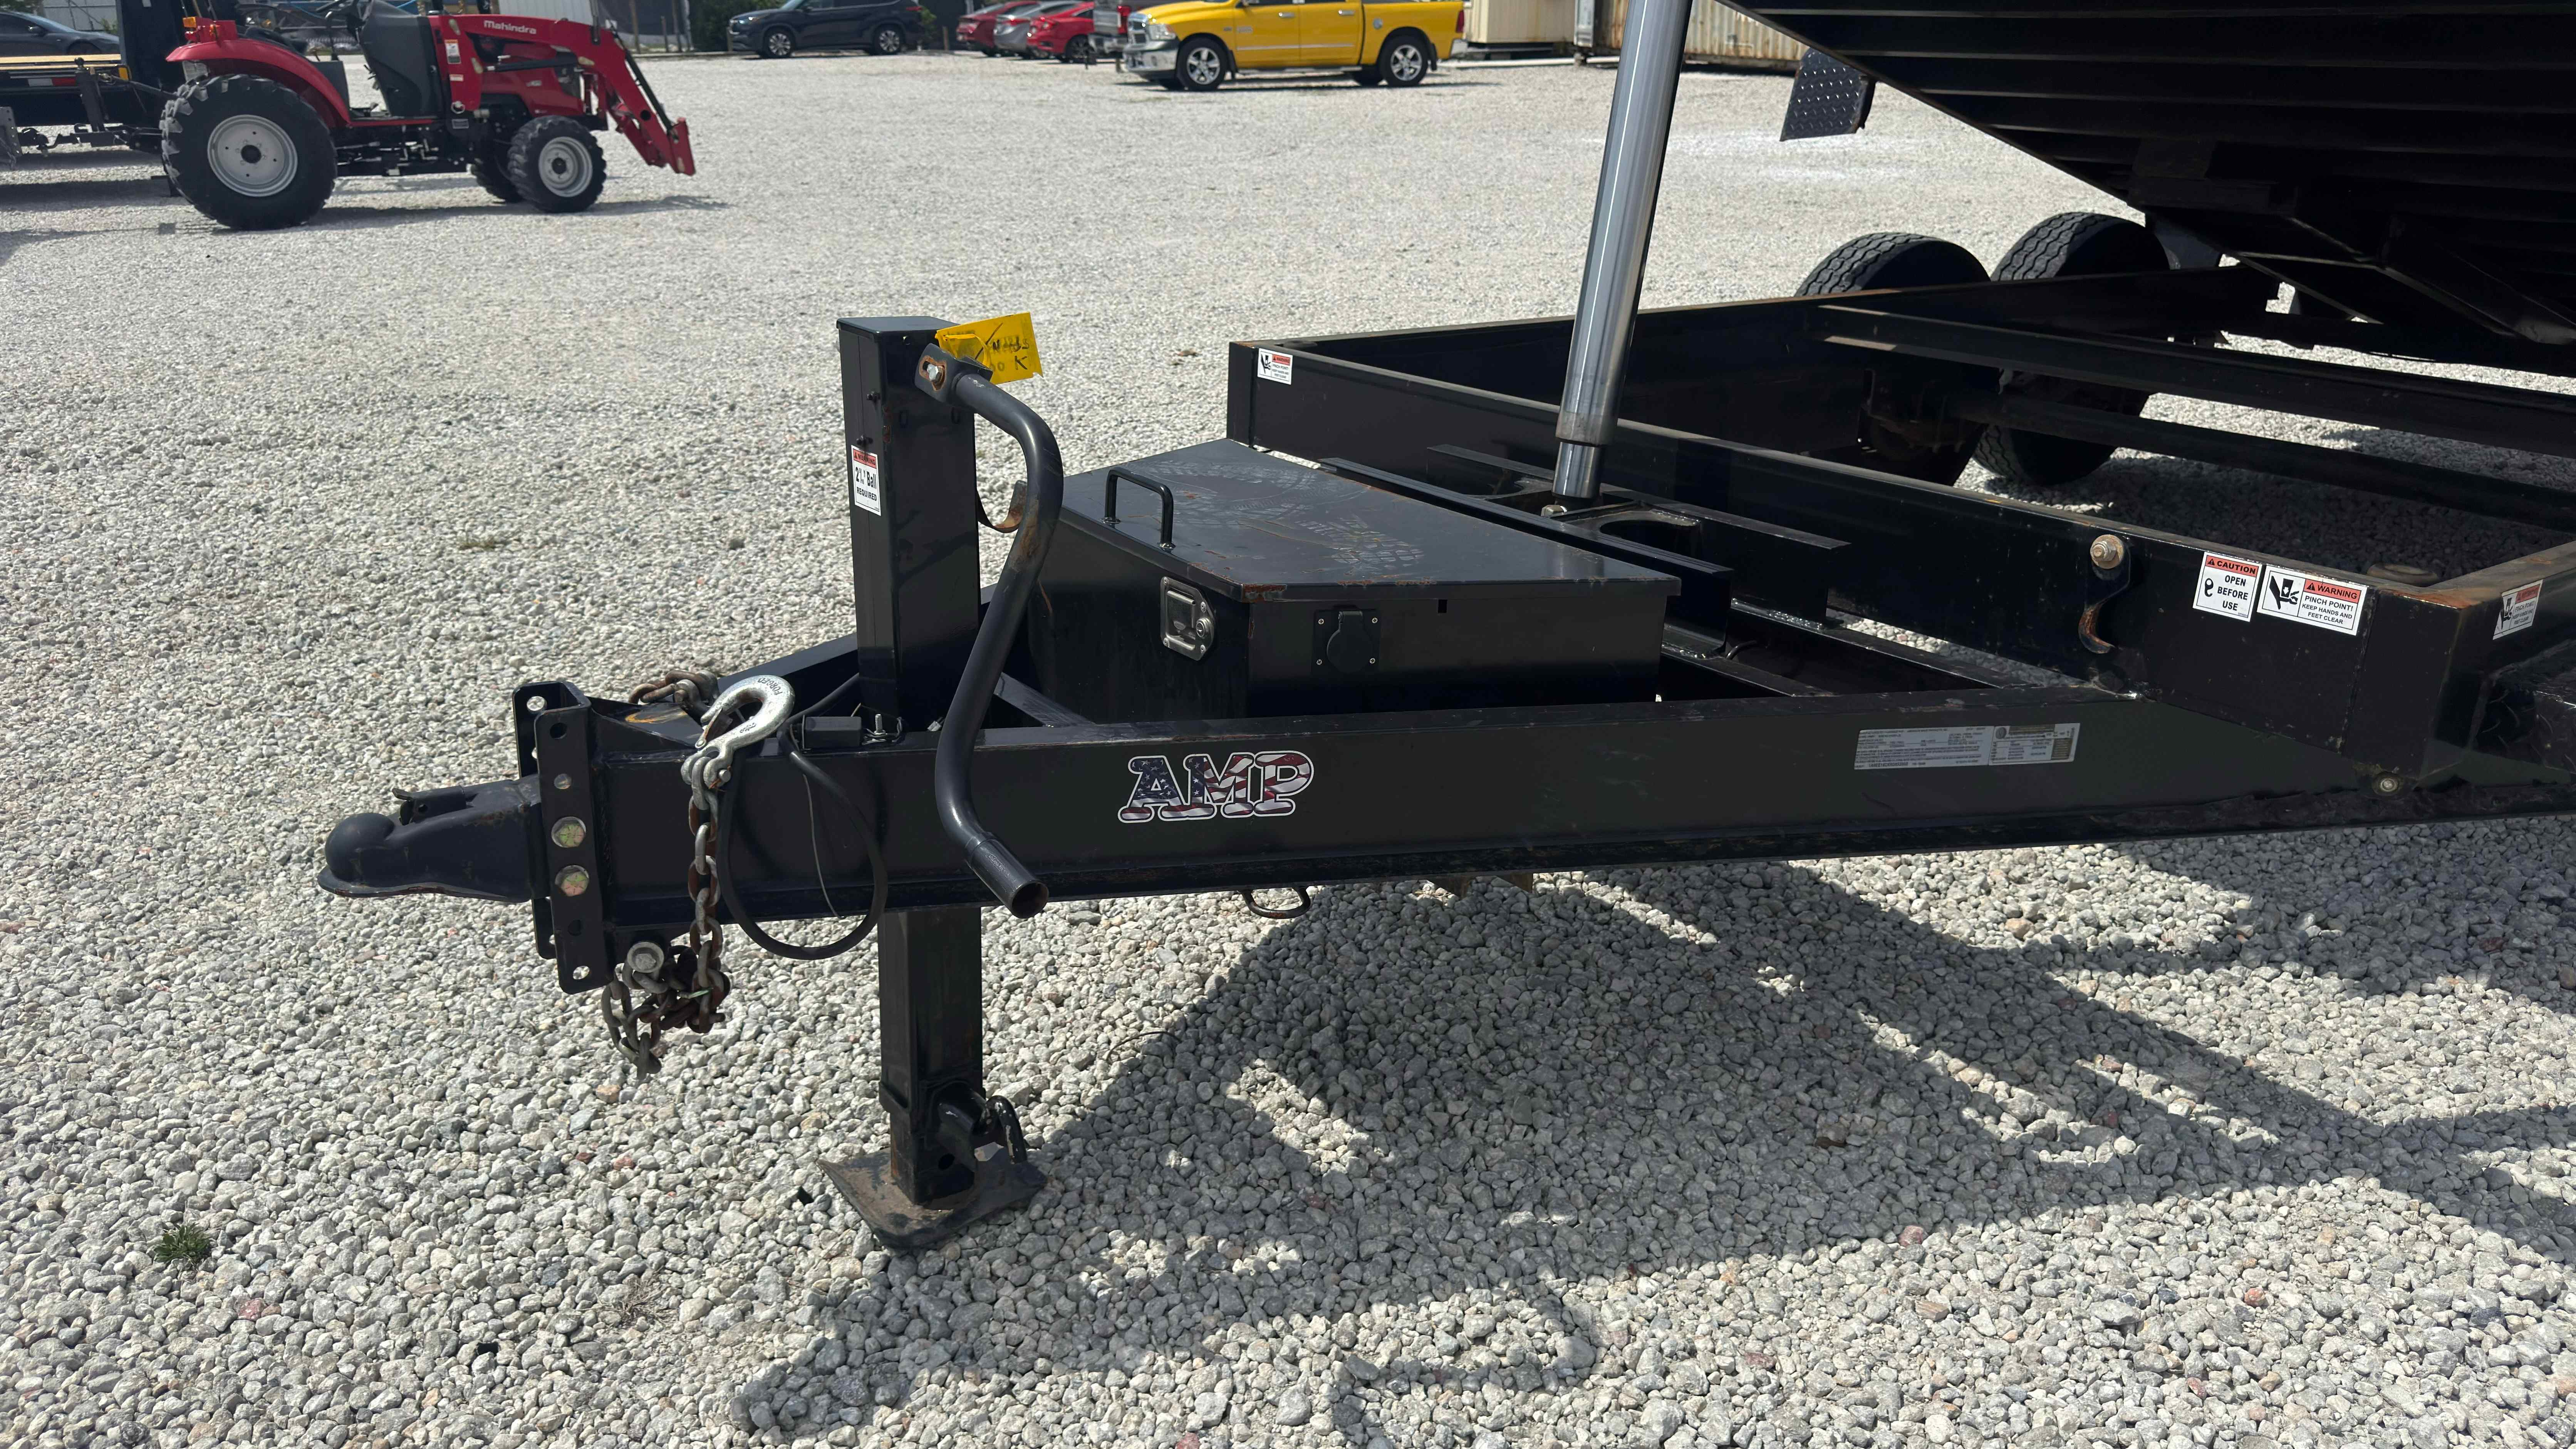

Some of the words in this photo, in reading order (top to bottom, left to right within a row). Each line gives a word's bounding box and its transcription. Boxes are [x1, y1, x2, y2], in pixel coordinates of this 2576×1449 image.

[484, 20, 536, 34] Mahindra
[858, 454, 876, 465] WARNING
[867, 471, 877, 489] Ball
[857, 487, 877, 501] REQUIRED
[2217, 560, 2256, 574] CAUTION
[2225, 575, 2246, 587] OPEN
[2217, 586, 2249, 600] BEFORE
[2318, 585, 2357, 599] WARNING
[2222, 600, 2238, 611] USE
[2305, 595, 2327, 605] PINCH
[2329, 601, 2353, 611] POINT!
[2318, 607, 2339, 616] HANDS
[2324, 616, 2343, 624] CLEAR
[757, 677, 783, 696] FORGED
[1117, 750, 1314, 823] AMP
